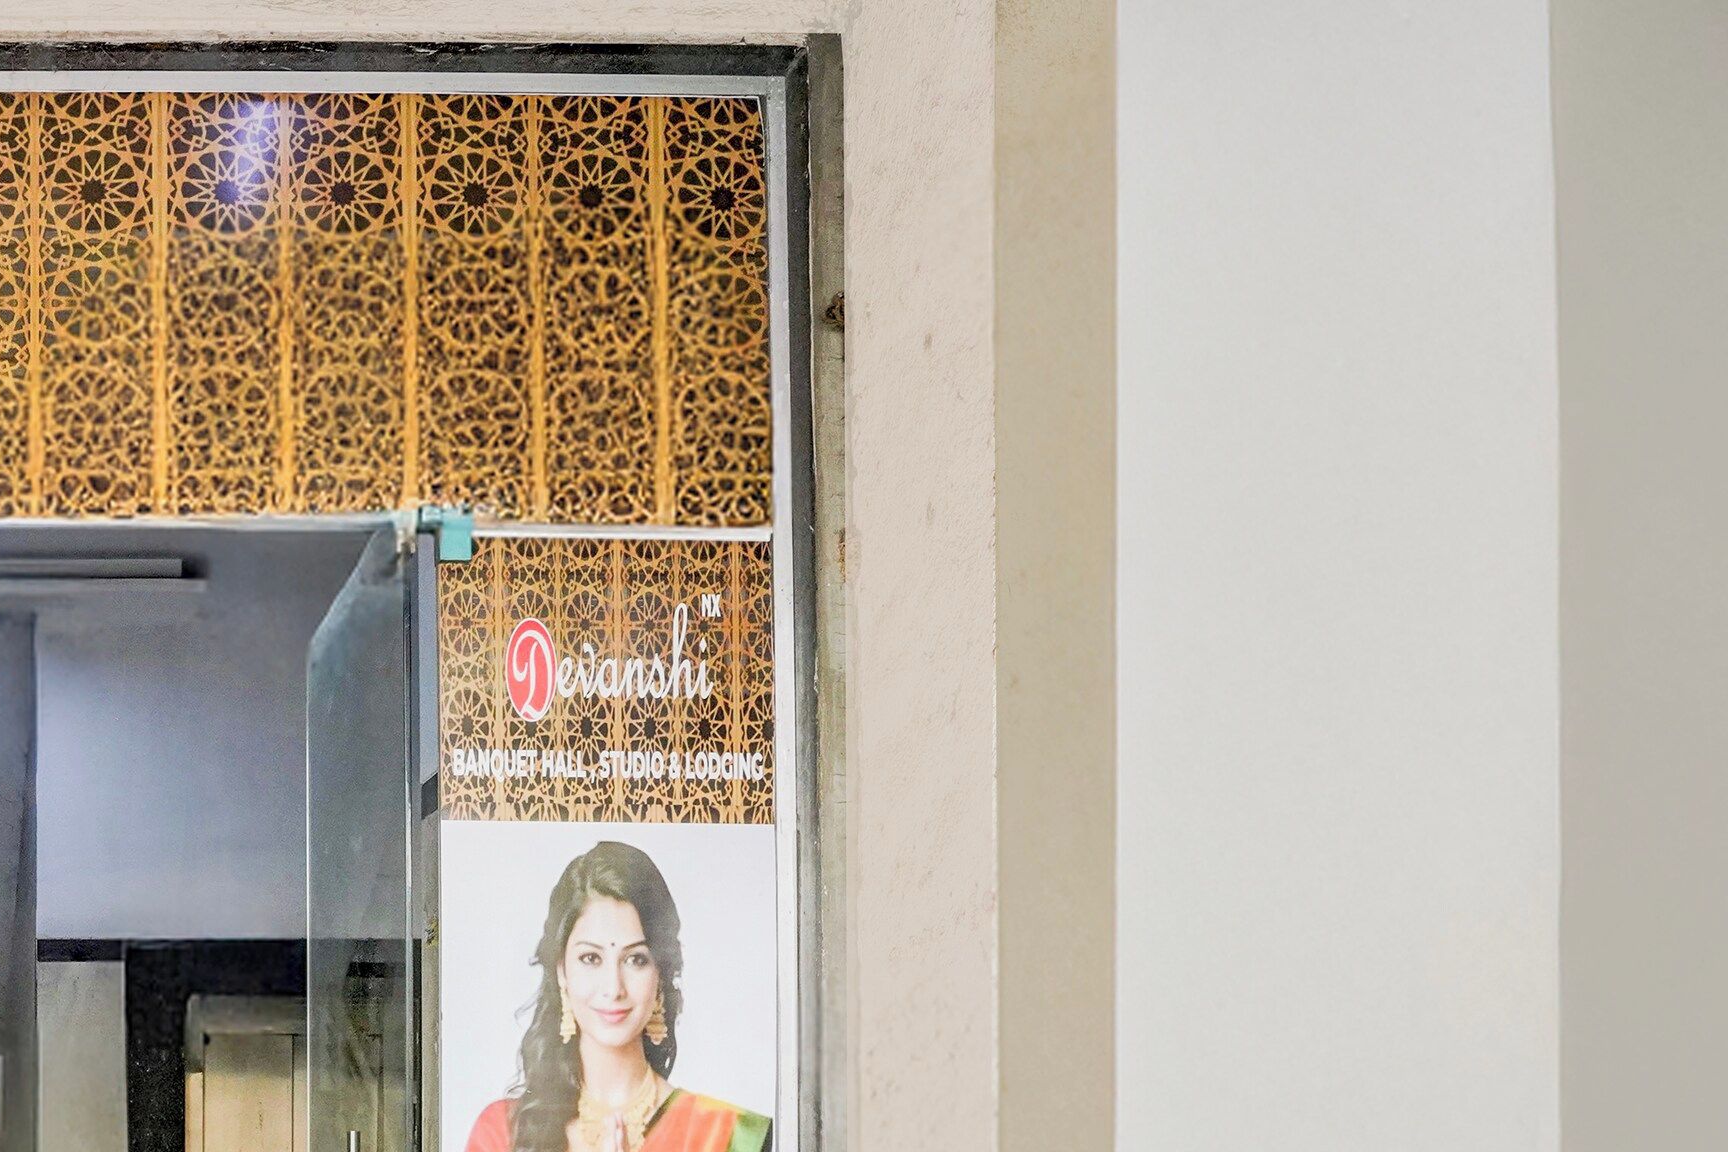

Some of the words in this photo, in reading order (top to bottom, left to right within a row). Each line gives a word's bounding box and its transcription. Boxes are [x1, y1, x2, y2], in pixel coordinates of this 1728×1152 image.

[506, 602, 714, 721] Devanshi
[701, 593, 722, 618] NX
[452, 748, 538, 783] BANQUET
[599, 750, 665, 780] STUDIO
[668, 751, 681, 780] &
[685, 751, 764, 781] LODGING
